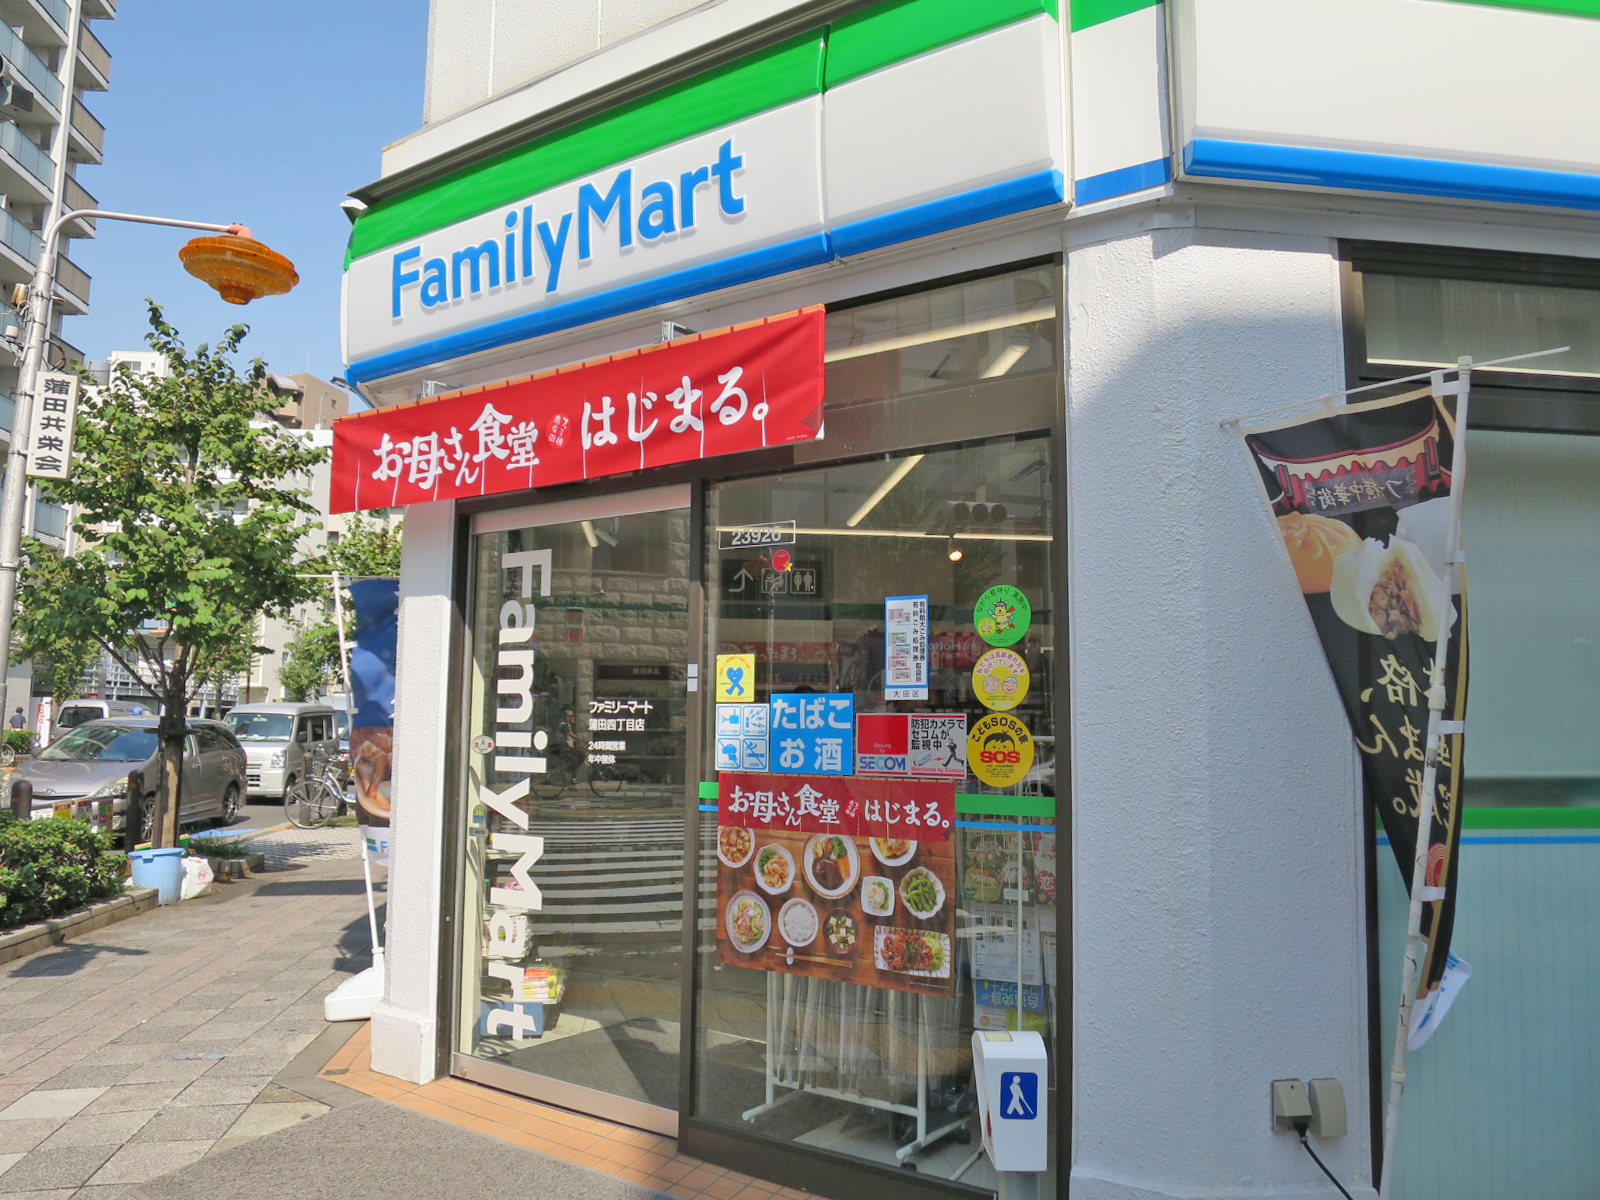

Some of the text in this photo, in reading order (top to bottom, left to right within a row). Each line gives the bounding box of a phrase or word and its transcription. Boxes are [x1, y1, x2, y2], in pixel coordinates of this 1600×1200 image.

[391, 136, 745, 319] FamilyMart
[35, 377, 70, 473] 蒲田共栄会
[371, 366, 769, 490] お母さん食堂 はじまる。
[731, 526, 782, 545] 23926
[893, 690, 920, 698] 大田区
[589, 700, 654, 714] ファミリーマート
[772, 697, 852, 729] たばこ
[588, 718, 645, 732] 蒲田四丁目店
[911, 718, 965, 730] 防犯カメラで
[911, 730, 949, 740] セコムが
[588, 741, 626, 751] 24時間営業
[911, 740, 942, 751] 監視中
[588, 754, 616, 765] 年中無休
[780, 738, 843, 772] お酒
[980, 750, 1021, 764] SOS
[859, 756, 906, 771] SECOM
[480, 548, 552, 1041] FamilyMart
[728, 783, 950, 829] お母さん食堂 はじまる。
